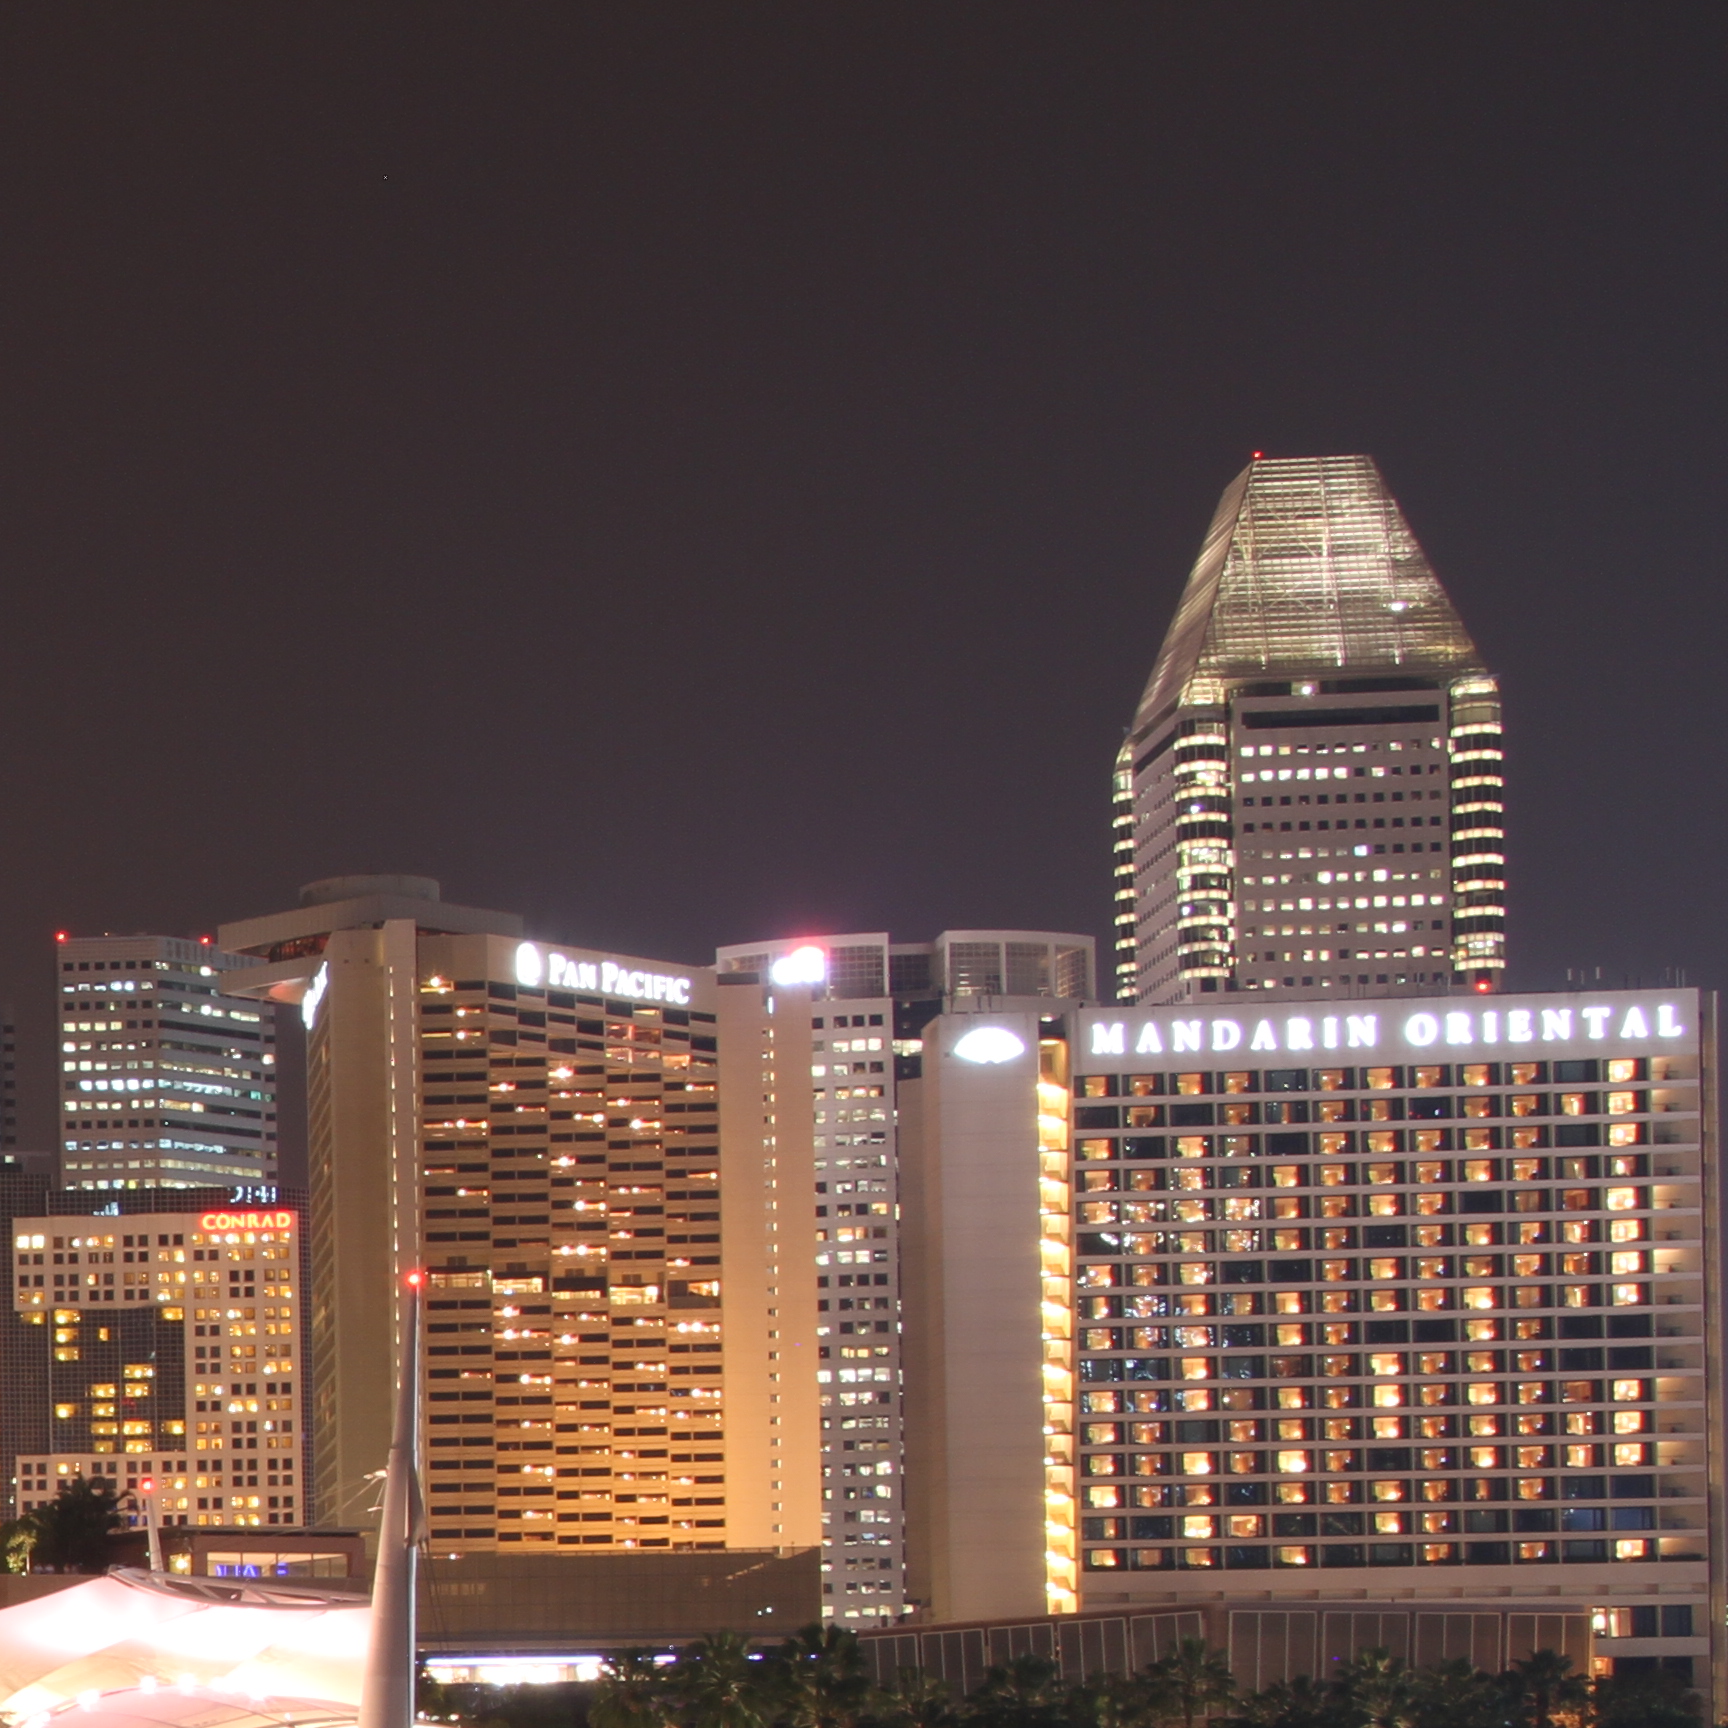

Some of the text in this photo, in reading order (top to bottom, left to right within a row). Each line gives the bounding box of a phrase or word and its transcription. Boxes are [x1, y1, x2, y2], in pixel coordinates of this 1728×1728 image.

[548, 952, 691, 1005] PAN PACIFIC
[1091, 1004, 1683, 1055] MANDARIN ORIENTAL
[201, 1211, 292, 1231] CONRAD
